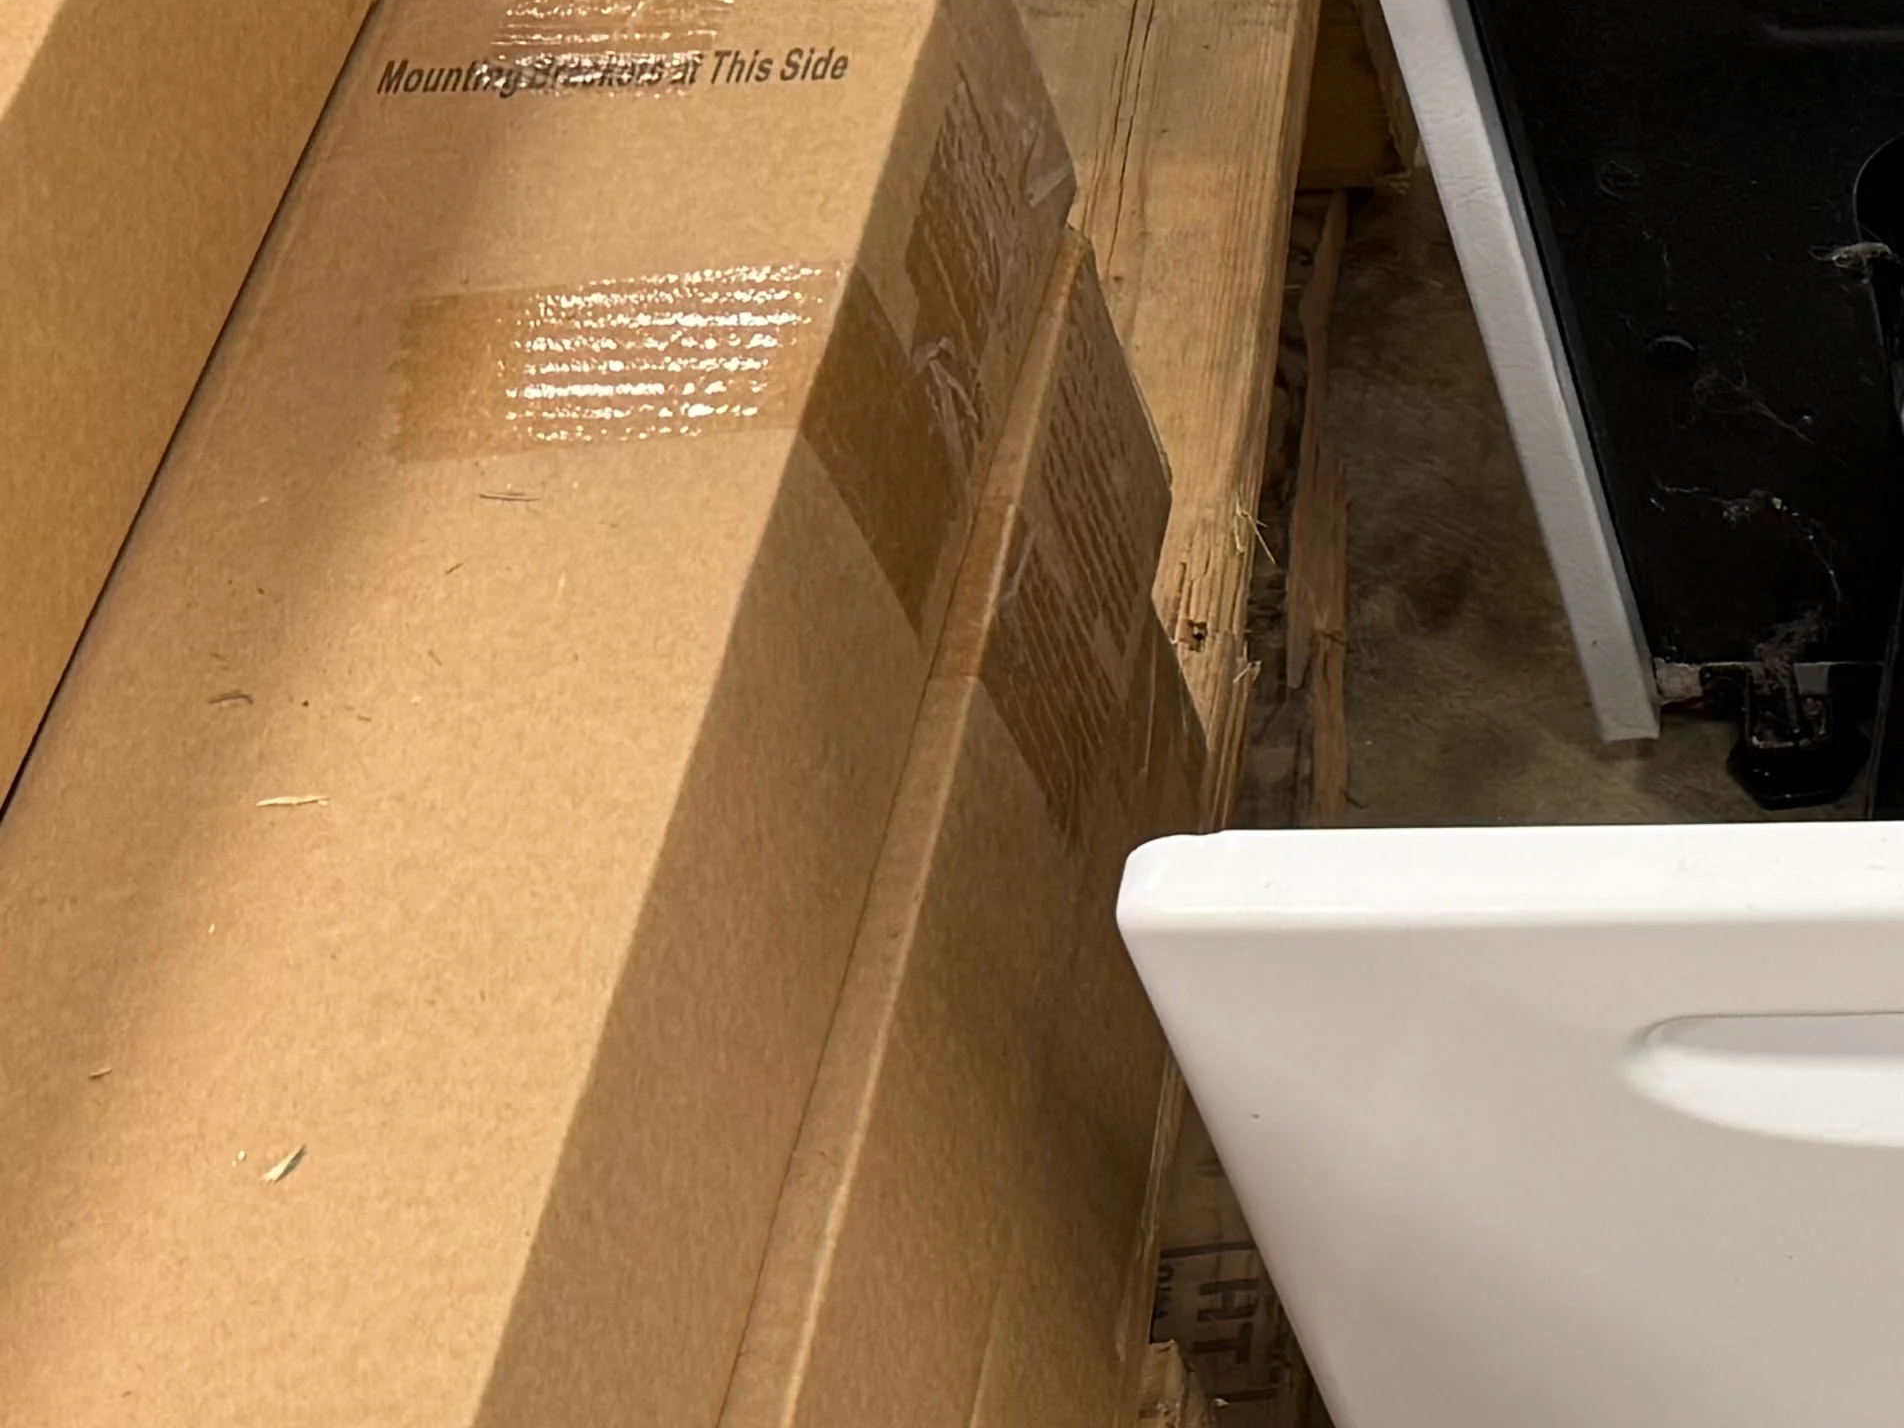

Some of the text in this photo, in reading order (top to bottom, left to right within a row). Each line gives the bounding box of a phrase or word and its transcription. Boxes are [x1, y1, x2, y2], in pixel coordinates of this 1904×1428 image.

[710, 49, 773, 85] This
[780, 46, 849, 83] Side
[1190, 1277, 1260, 1364] HT
